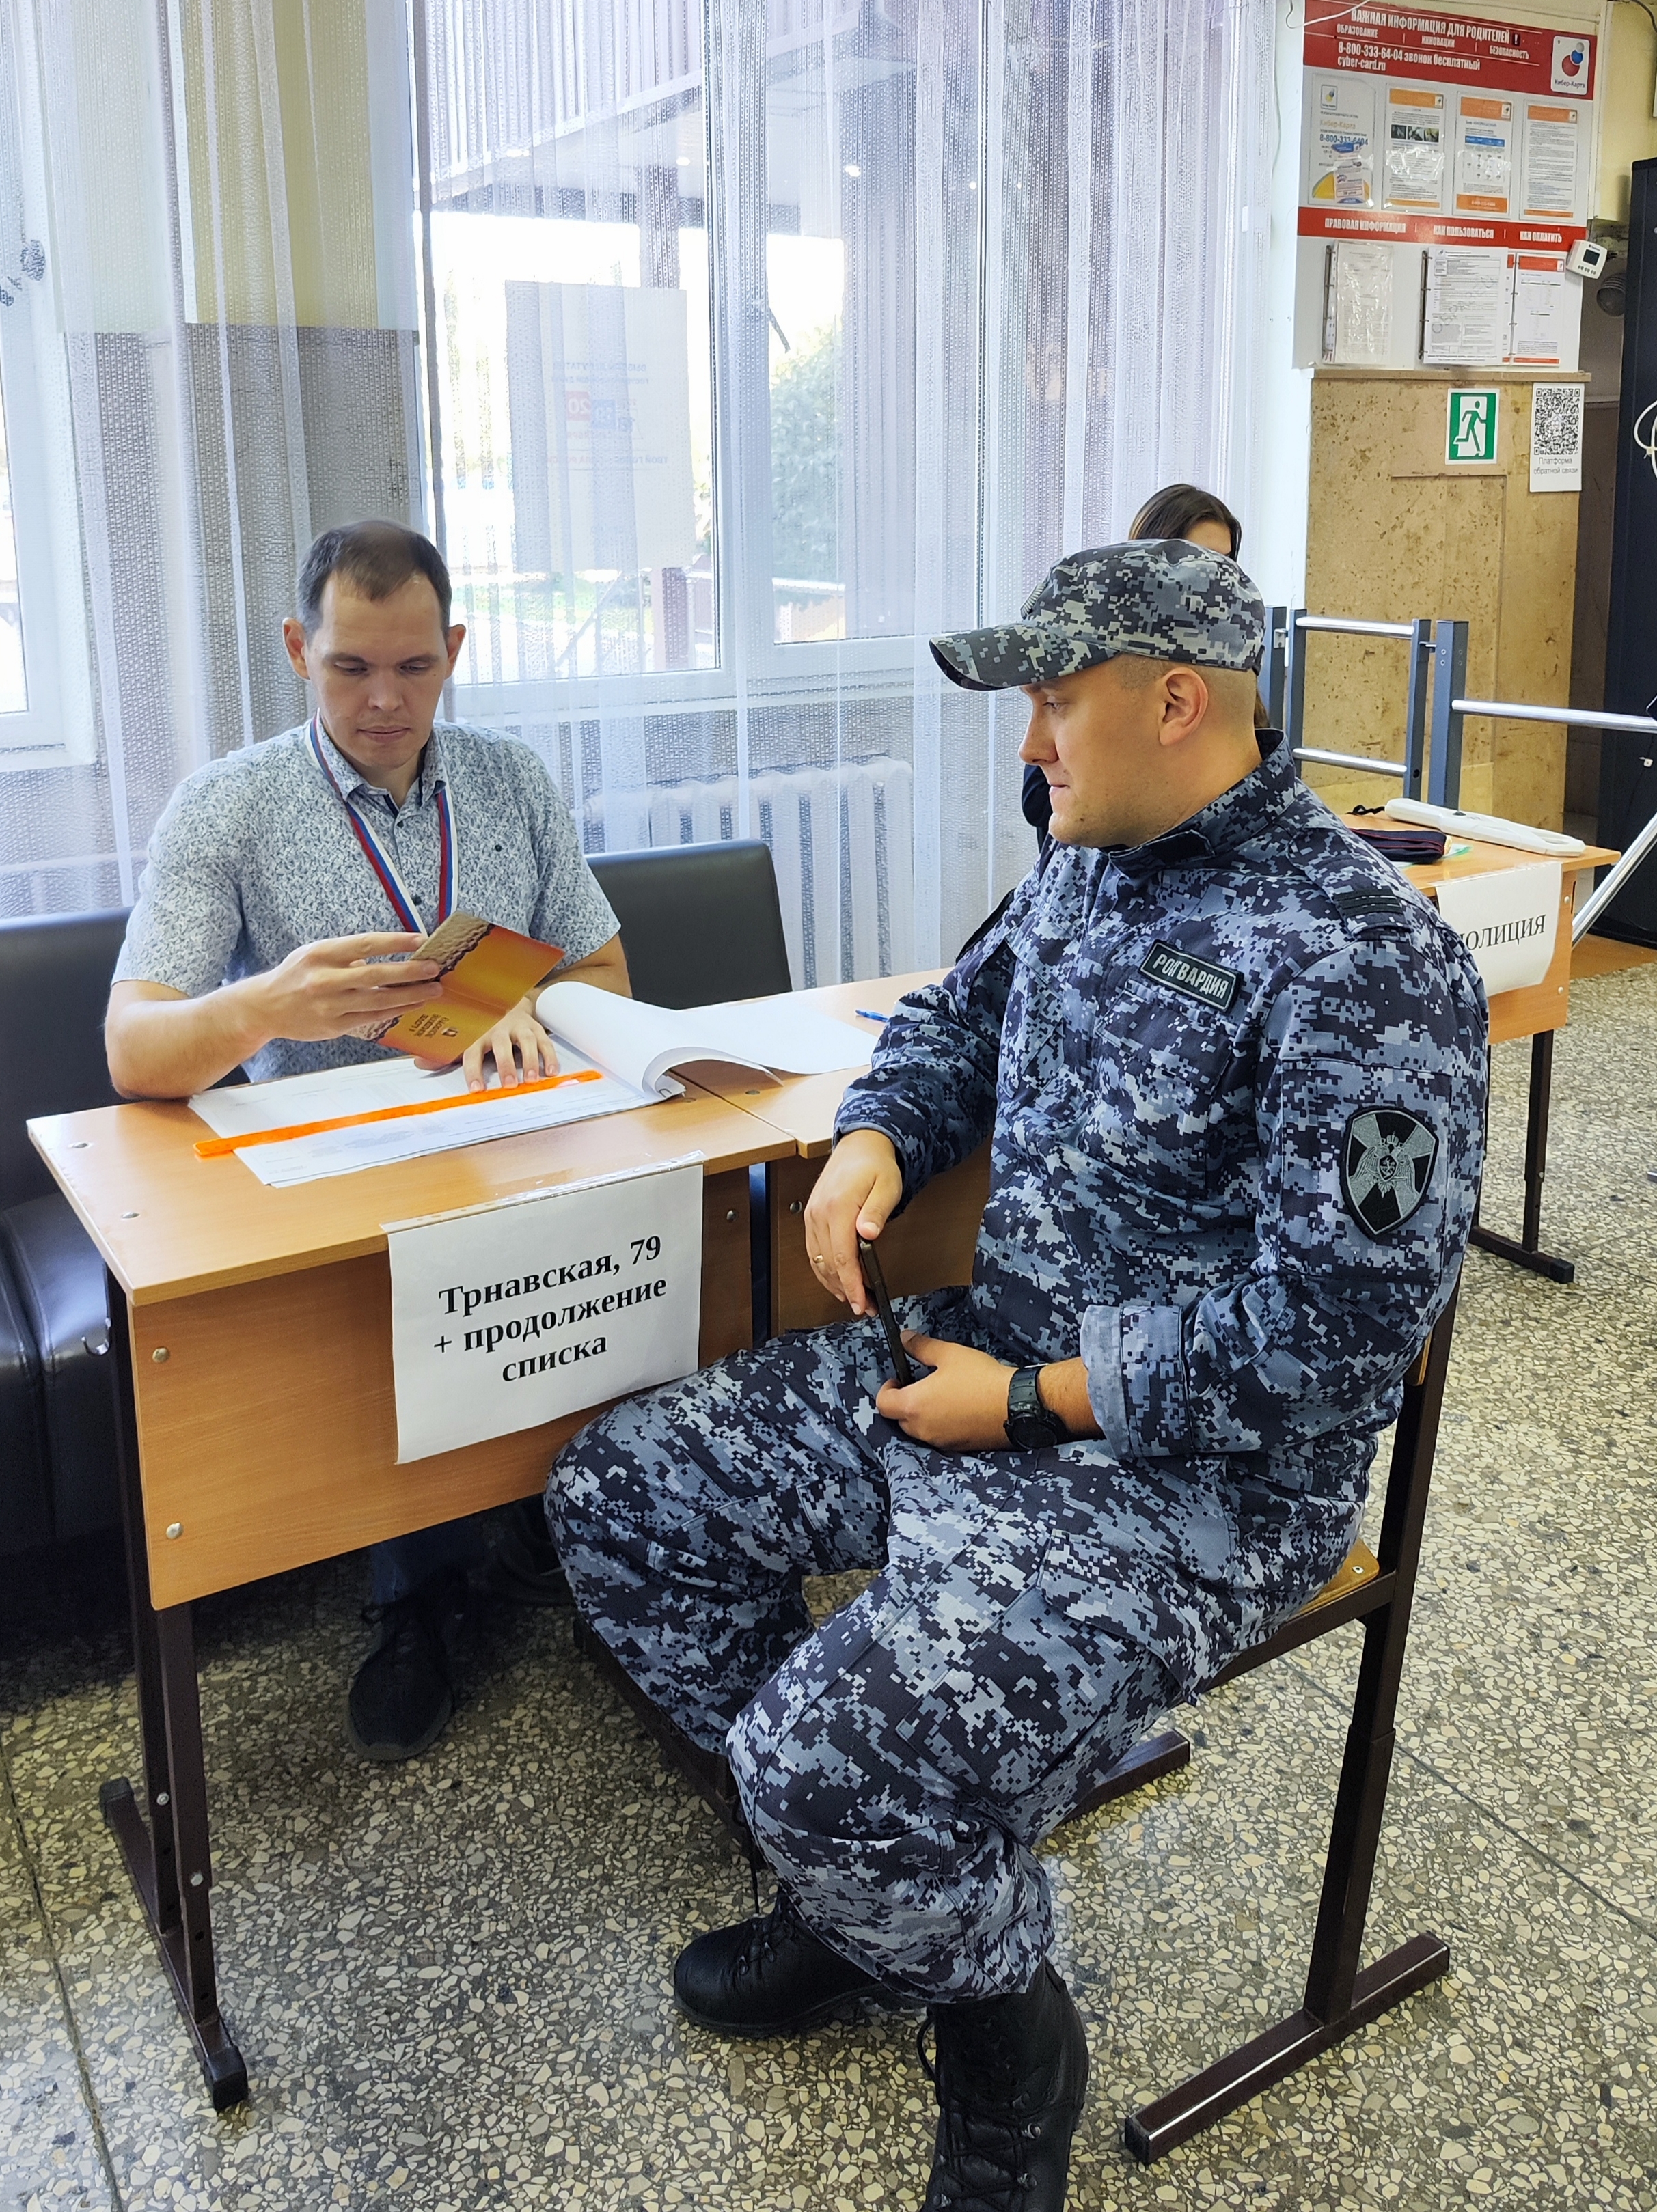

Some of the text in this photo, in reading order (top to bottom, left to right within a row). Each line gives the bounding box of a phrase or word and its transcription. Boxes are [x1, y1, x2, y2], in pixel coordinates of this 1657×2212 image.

[1337, 24, 1378, 38] ОБРАЗОВАНИЕ
[1351, 9, 1387, 27] ВАЖНАЯ
[1388, 14, 1447, 35] ИНФОРМАЦИЯ
[1447, 23, 1465, 37] ДЛЯ
[1466, 26, 1510, 44] РОДИТЕЛЕЙ
[1421, 35, 1455, 49] ИННОВАЦИИ
[1338, 41, 1481, 71] 8-800-333-64-04 звонок бесплатный
[1489, 45, 1530, 59] БЕЗОПАСНОСТЬ
[1337, 56, 1386, 71] cyber-card.ru
[1555, 79, 1585, 89] Кибер-Карта
[1325, 217, 1406, 234] ПРАВОВАЯ ИНФОРМАЦИЯ
[1433, 225, 1494, 239] КАК ПОЛЬЗОВАТЬСЯ
[1520, 231, 1563, 243] КАК ОПЛАТИТЬ
[1533, 467, 1561, 475] обратной
[438, 1235, 661, 1318] Трнавская, 79
[433, 1277, 668, 1354] + продолжение
[502, 1336, 607, 1383] списка
